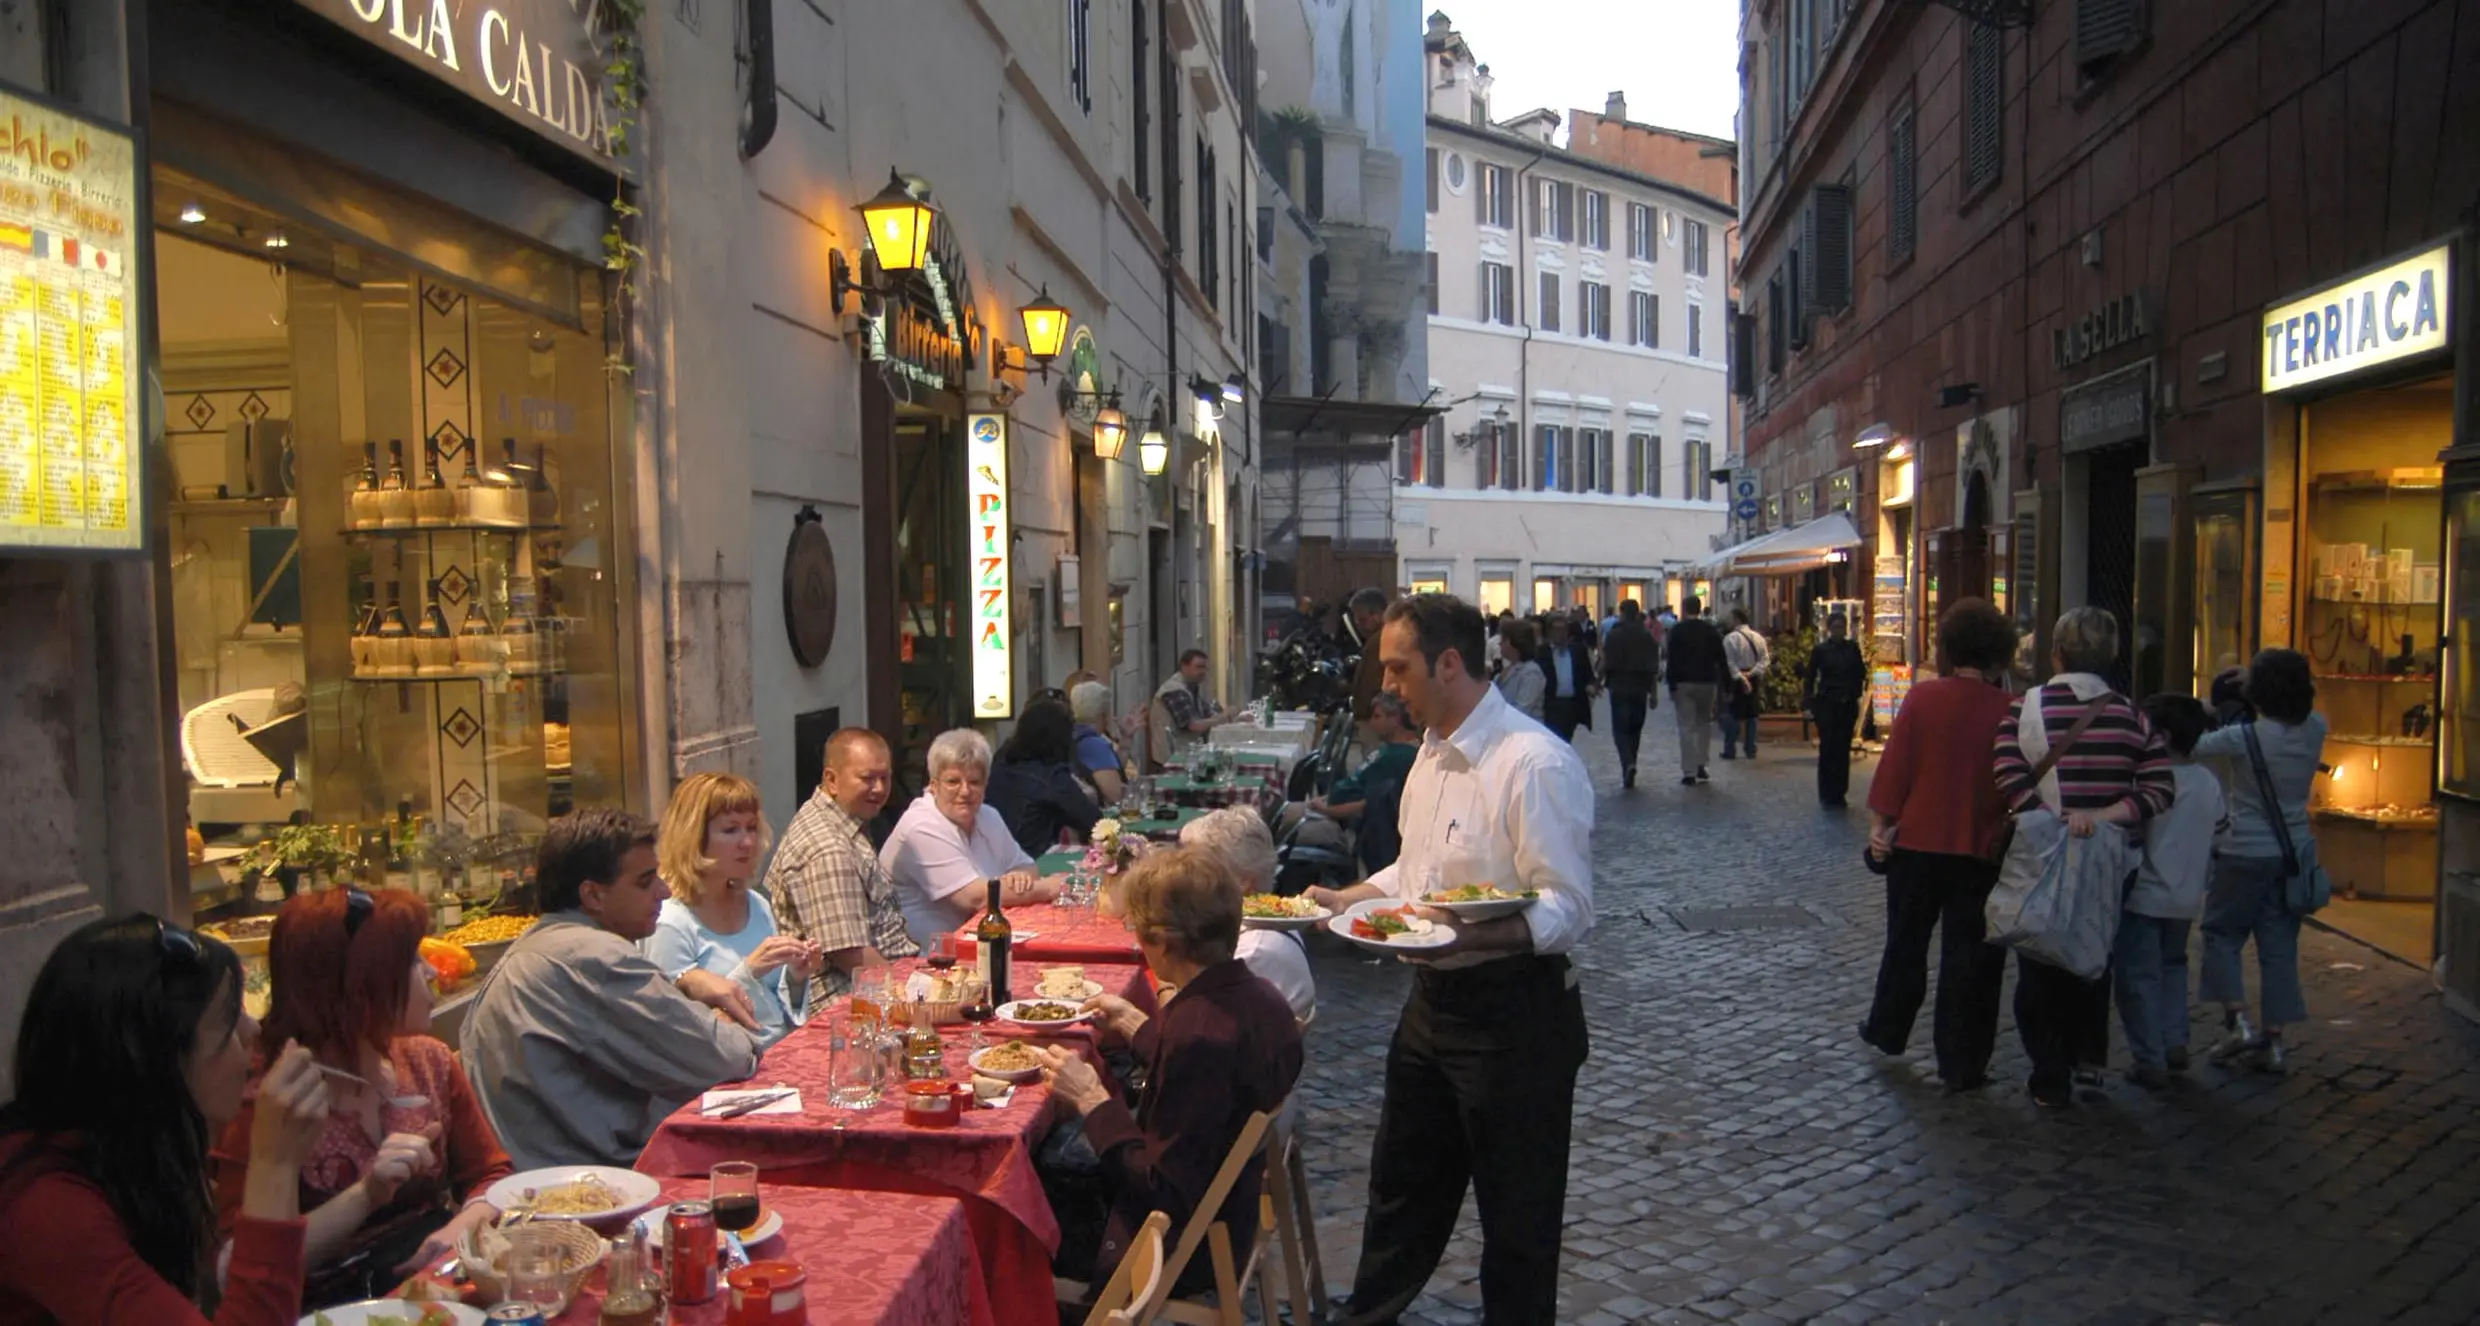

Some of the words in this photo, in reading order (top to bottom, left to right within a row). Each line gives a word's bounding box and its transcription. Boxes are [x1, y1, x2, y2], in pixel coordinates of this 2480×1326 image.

[480, 9, 614, 157] CALDA
[29, 166, 73, 192] Pizzeria
[81, 183, 121, 208] Birreria
[2079, 290, 2147, 361] SELLA
[2265, 269, 2438, 377] TERRIACA
[977, 493, 1005, 650] PIZZA
